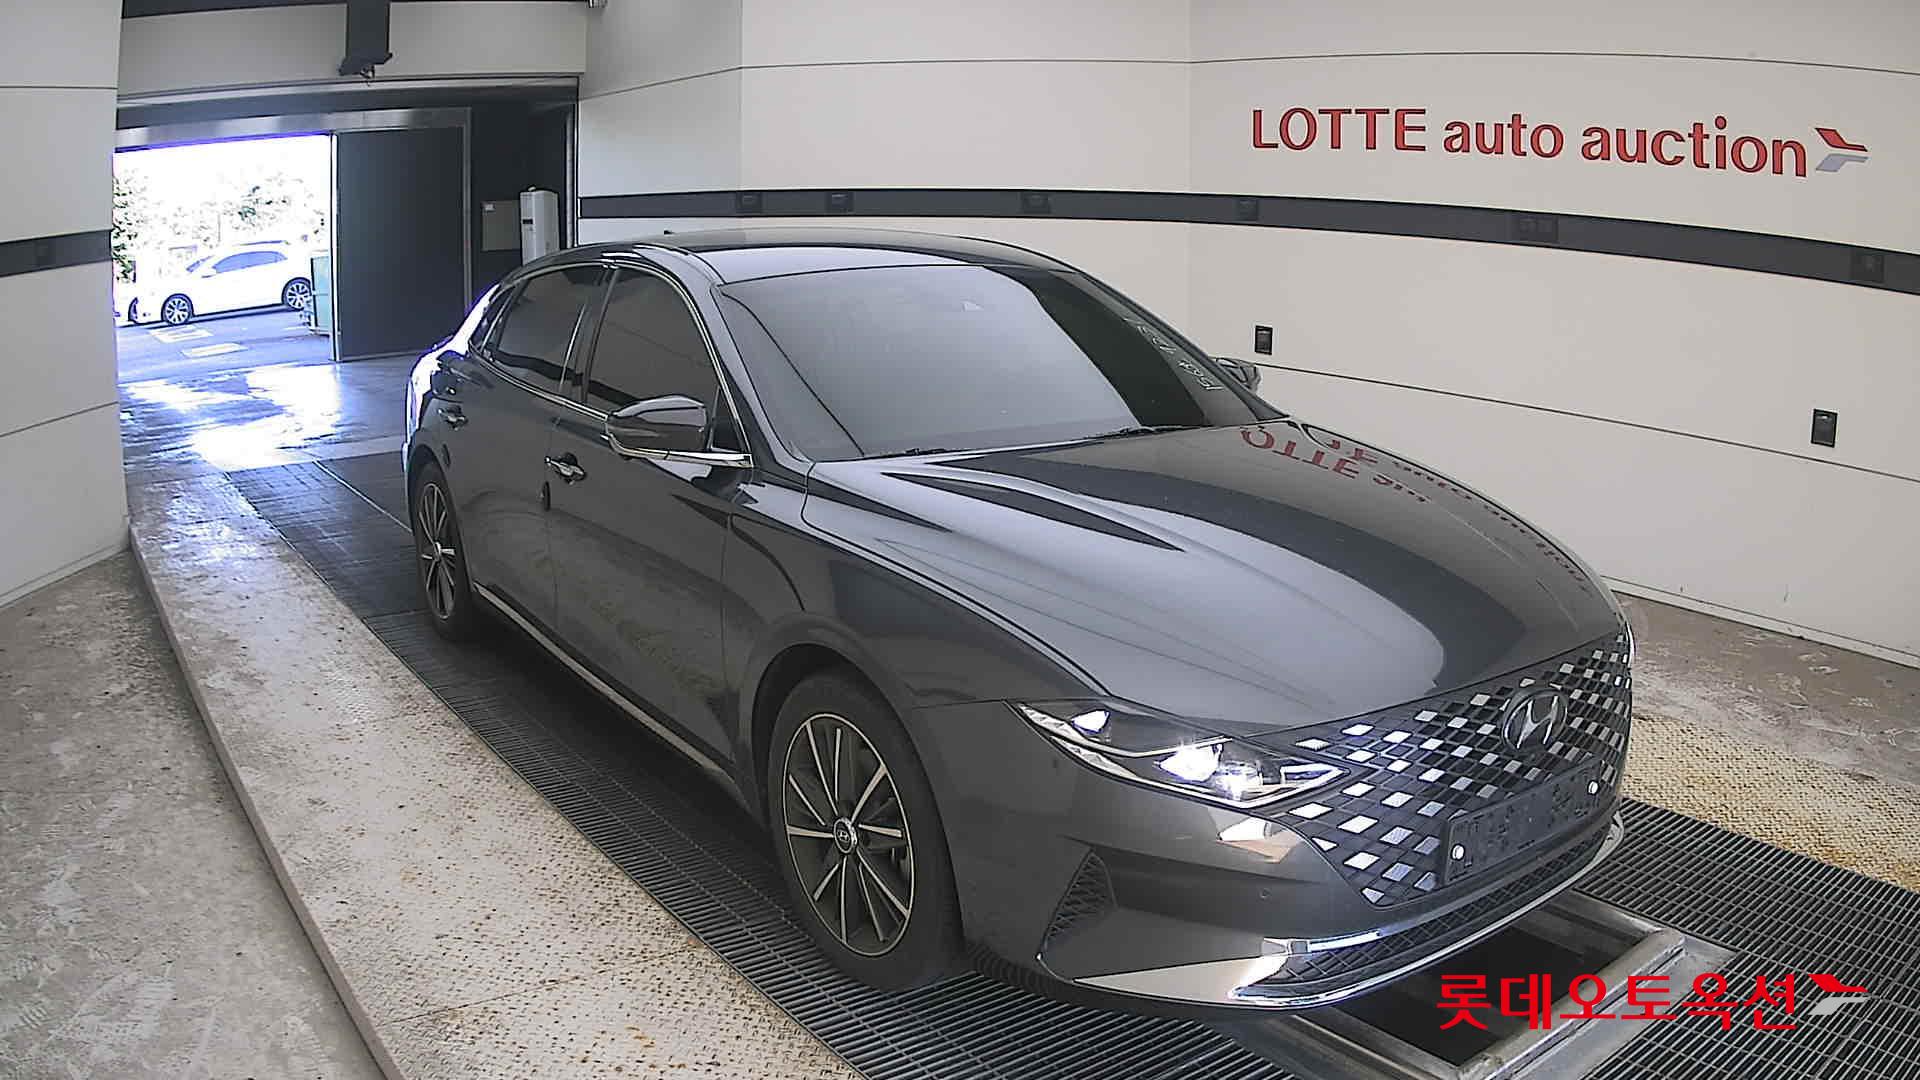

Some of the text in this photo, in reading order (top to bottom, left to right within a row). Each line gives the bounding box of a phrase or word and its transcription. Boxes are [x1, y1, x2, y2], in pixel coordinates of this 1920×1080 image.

[1252, 107, 1808, 178] LOTTE auto auction
